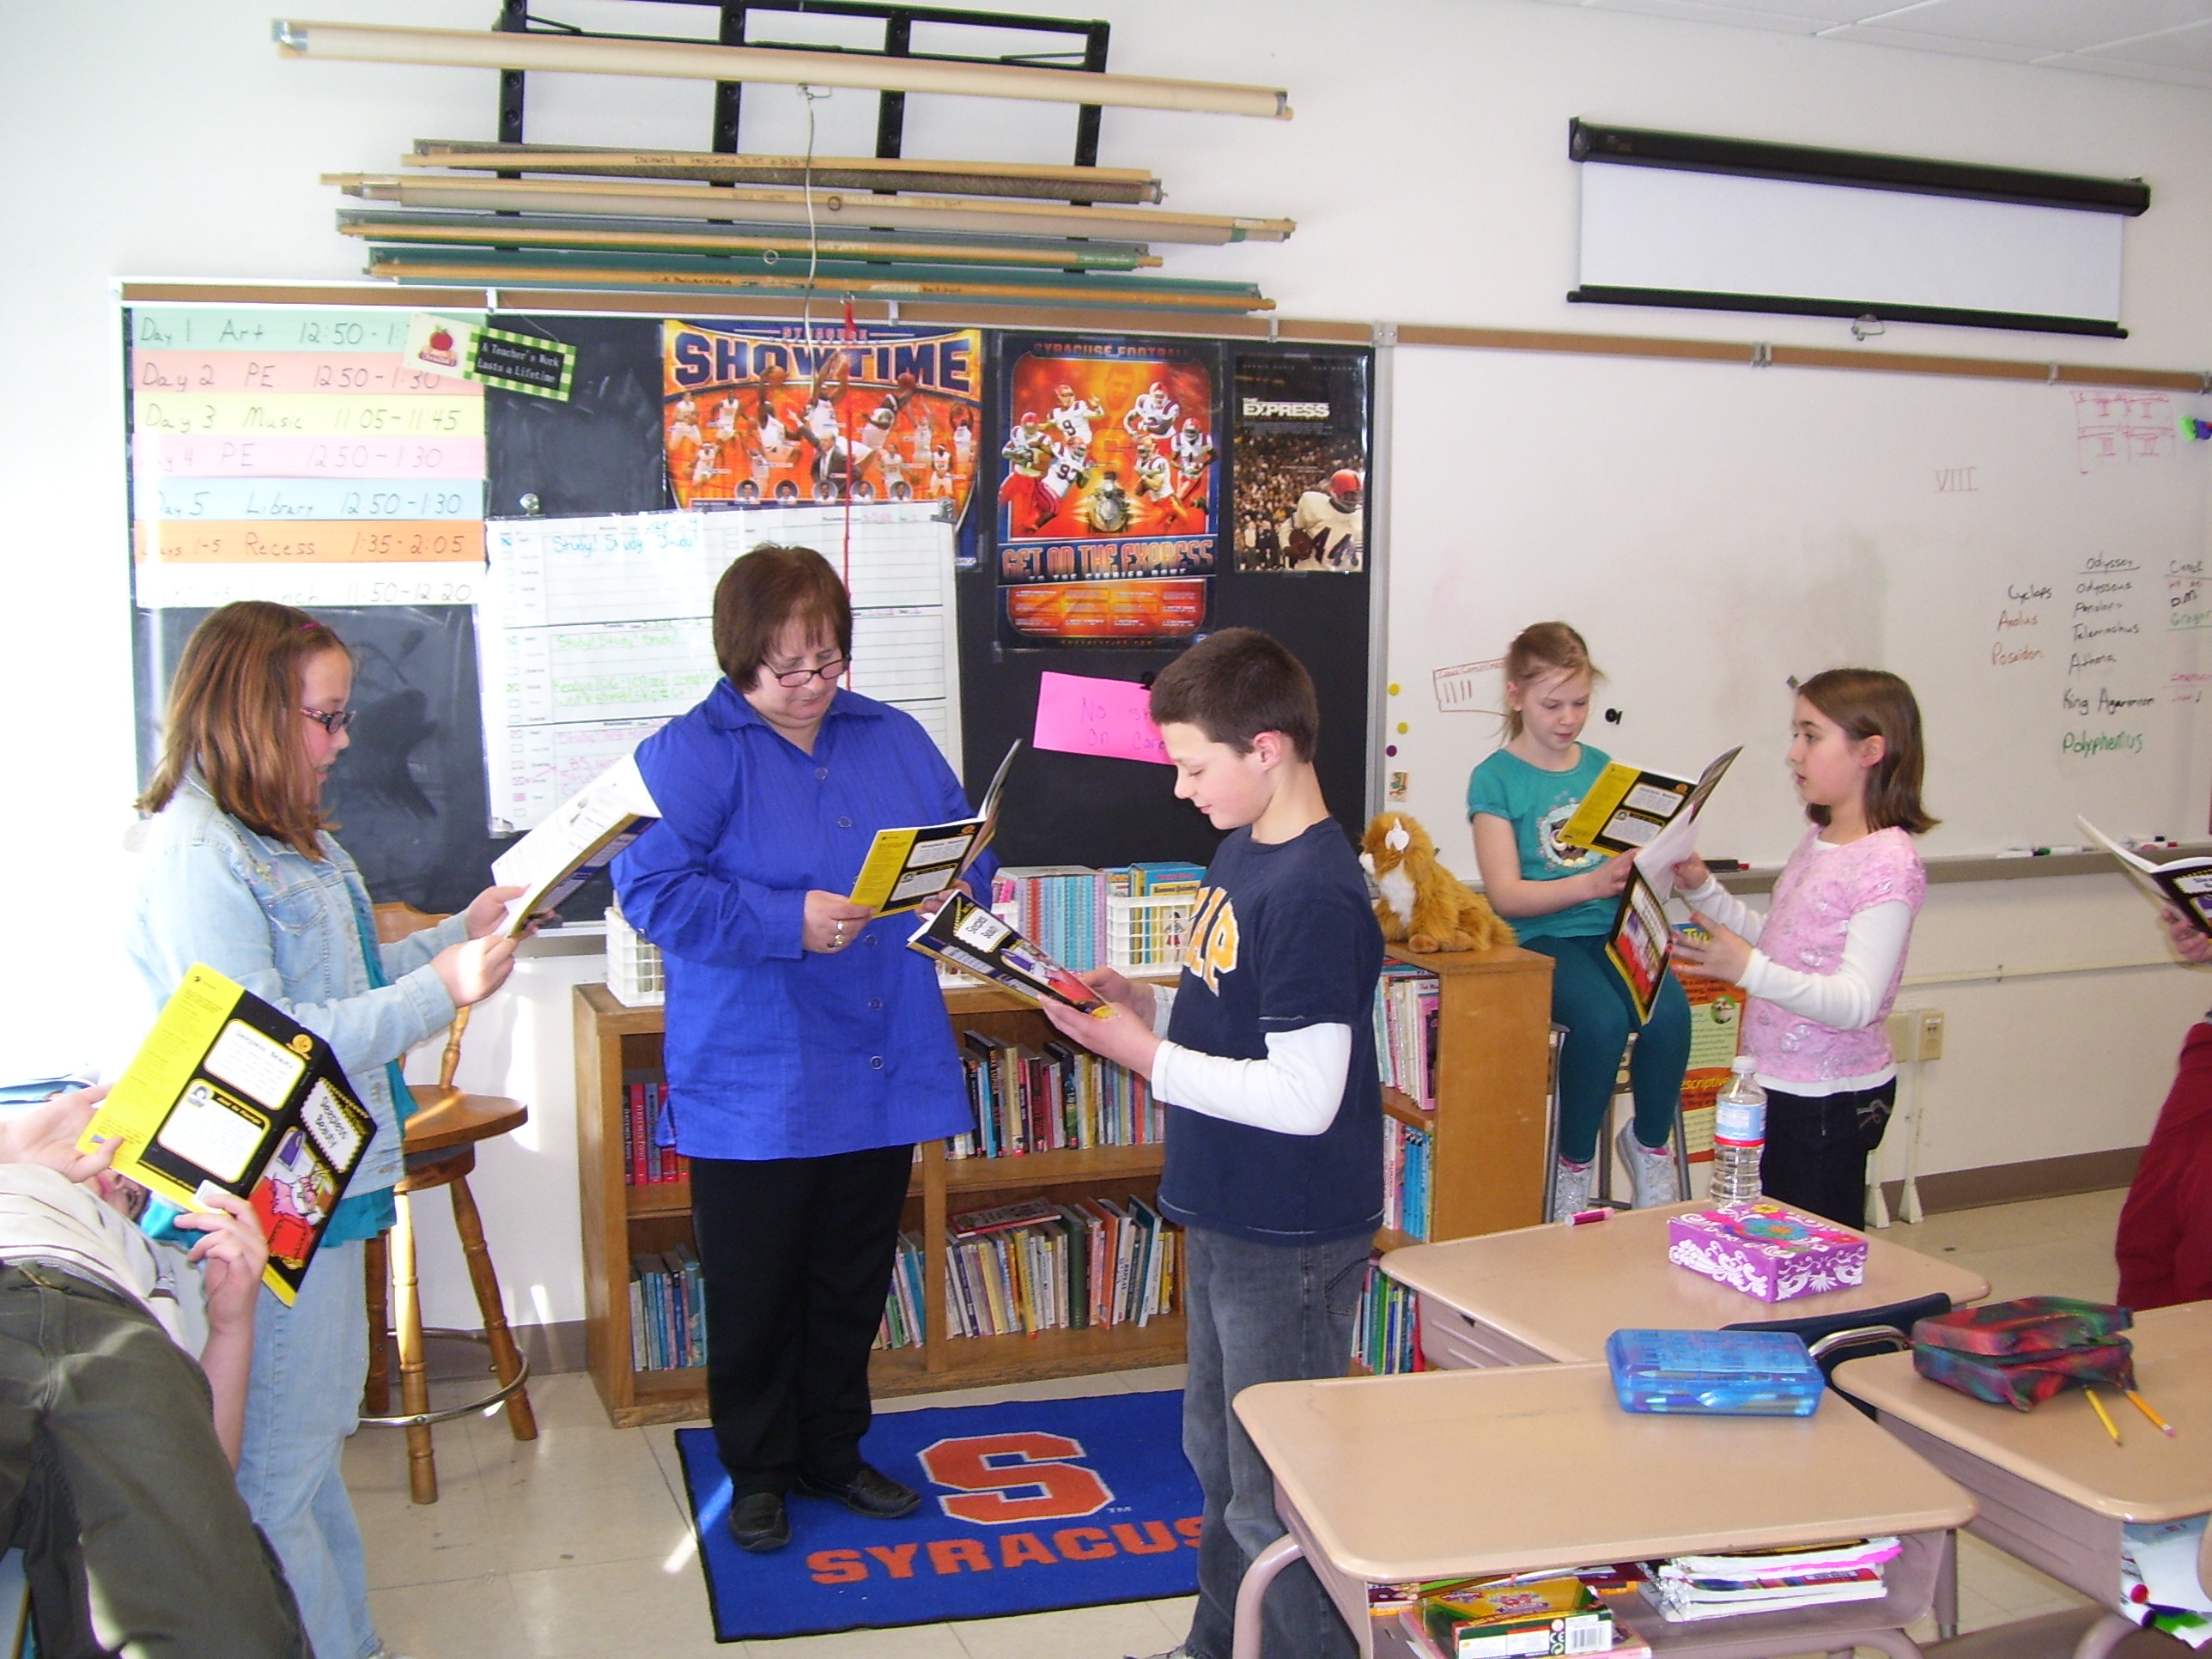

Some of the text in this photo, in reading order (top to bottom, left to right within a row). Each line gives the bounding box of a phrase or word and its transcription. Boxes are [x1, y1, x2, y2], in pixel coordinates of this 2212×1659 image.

[141, 317, 172, 345] Day
[185, 319, 191, 342] 1
[219, 319, 264, 342] Art
[675, 331, 972, 394] SHOWTIME
[143, 362, 188, 392] Day
[199, 364, 215, 386] 2
[144, 403, 191, 434] Day
[201, 404, 216, 428] 3
[242, 406, 303, 429] Music
[1242, 401, 1331, 417] EXPRESS
[189, 490, 211, 516] 5
[245, 491, 315, 517] Library
[245, 531, 317, 557] Recess
[1002, 539, 1214, 578] GET ON THE EXPRESS
[1079, 697, 1107, 723] No
[1086, 728, 1109, 746] On
[805, 1516, 1203, 1585] SYRACUS
